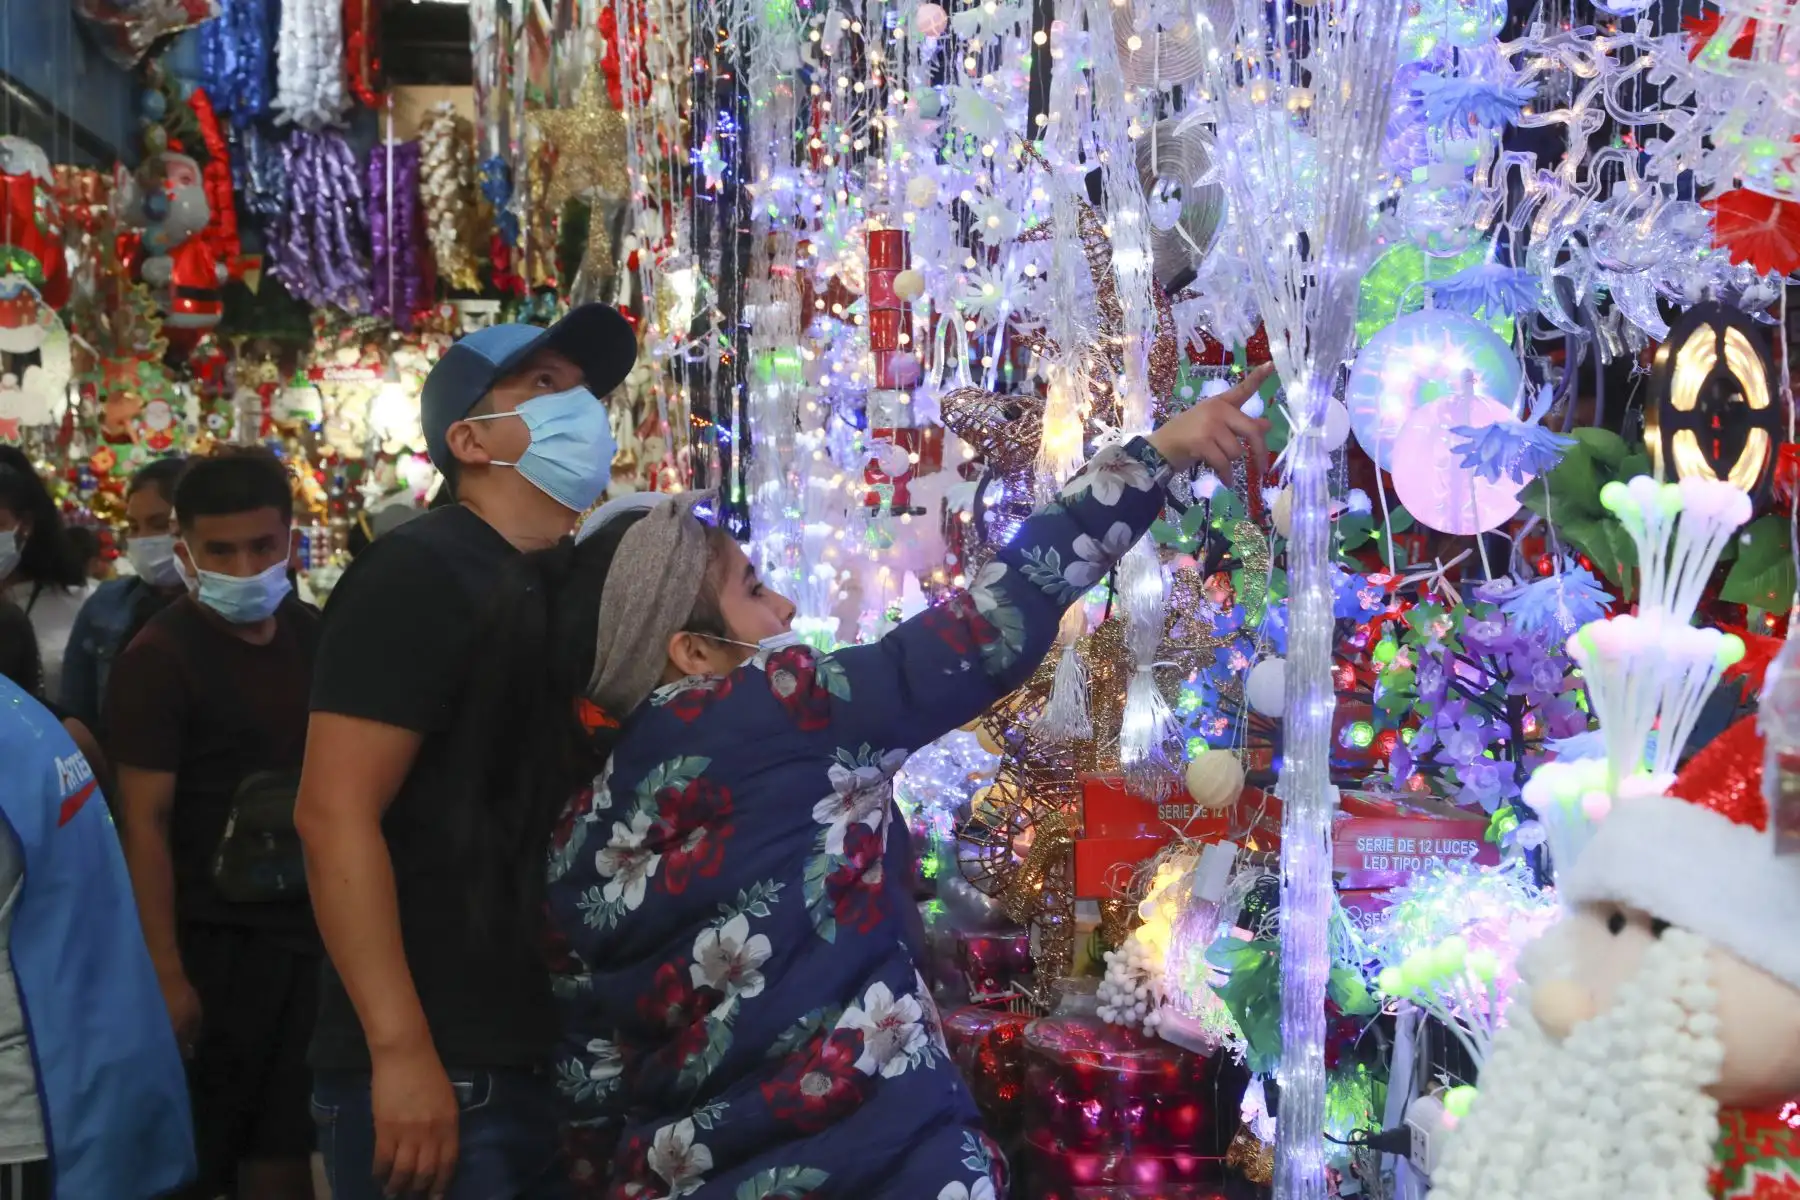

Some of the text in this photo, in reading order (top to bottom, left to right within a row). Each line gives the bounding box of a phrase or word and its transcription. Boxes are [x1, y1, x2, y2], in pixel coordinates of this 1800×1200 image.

[1158, 803, 1190, 819] SERIE
[1357, 838, 1477, 854] SERIE DE 12 LUCES
[1363, 856, 1389, 869] LED
[1392, 856, 1421, 870] TIPO
